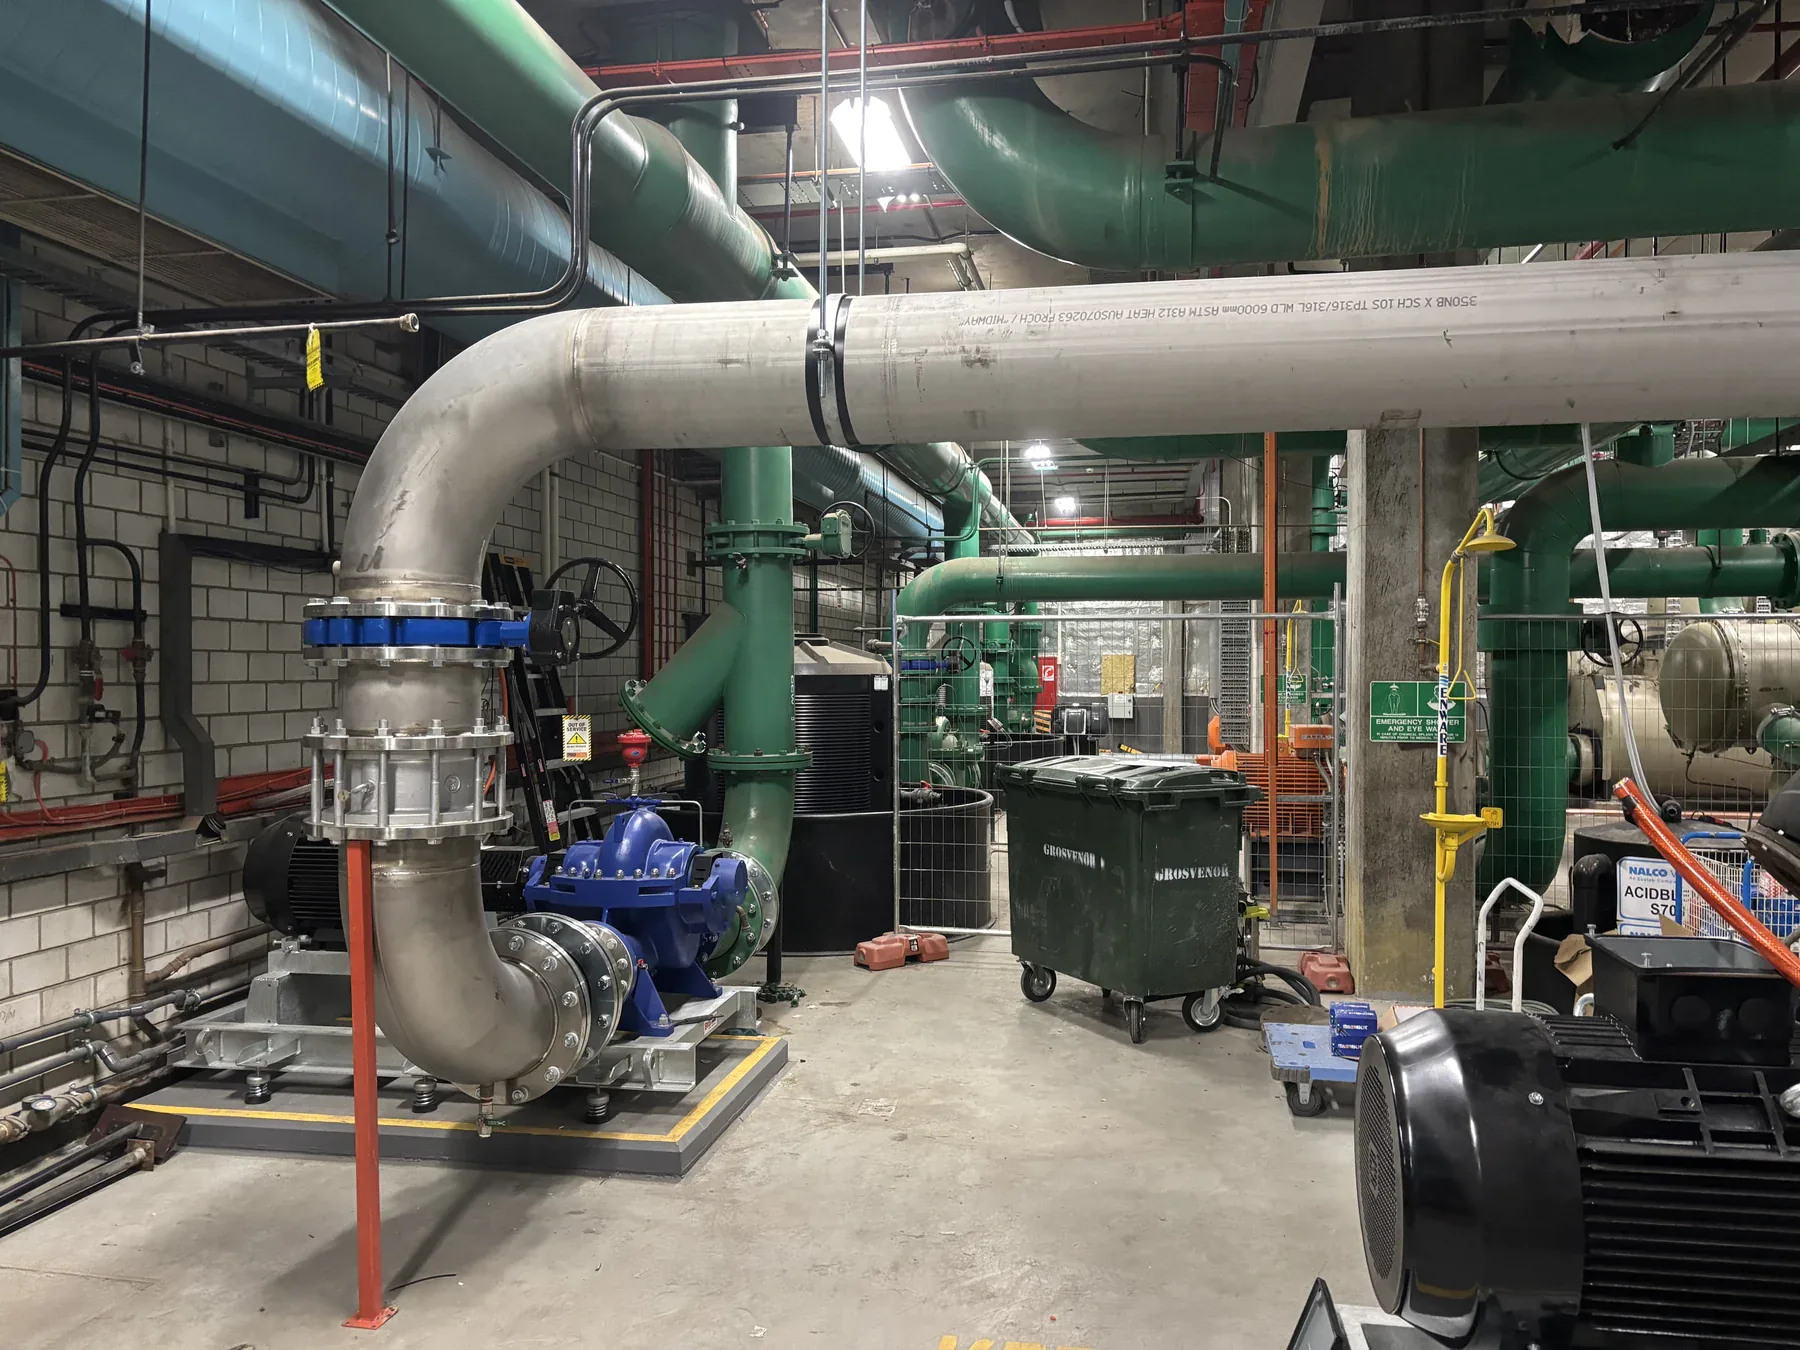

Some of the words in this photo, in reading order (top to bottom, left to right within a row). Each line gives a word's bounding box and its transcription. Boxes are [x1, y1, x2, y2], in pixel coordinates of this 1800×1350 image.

[1298, 300, 1368, 313] TP316/316L
[1372, 298, 1394, 310] 10S
[1397, 297, 1421, 309] SCH
[1424, 297, 1433, 308] X
[1436, 295, 1478, 308] 350NB
[1126, 308, 1155, 319] HEAT
[1158, 307, 1186, 318] A312
[1189, 306, 1219, 318] ASTM
[1222, 304, 1267, 315] 6000mm
[1271, 303, 1294, 314] WLD
[1020, 312, 1056, 324] FROCH
[1058, 309, 1124, 323] AUS070263
[1439, 687, 1448, 756] ENWARE
[1043, 843, 1096, 869] GROSVENOR
[1155, 865, 1229, 882] GROSVENOR
[1628, 866, 1668, 877] NALCO
